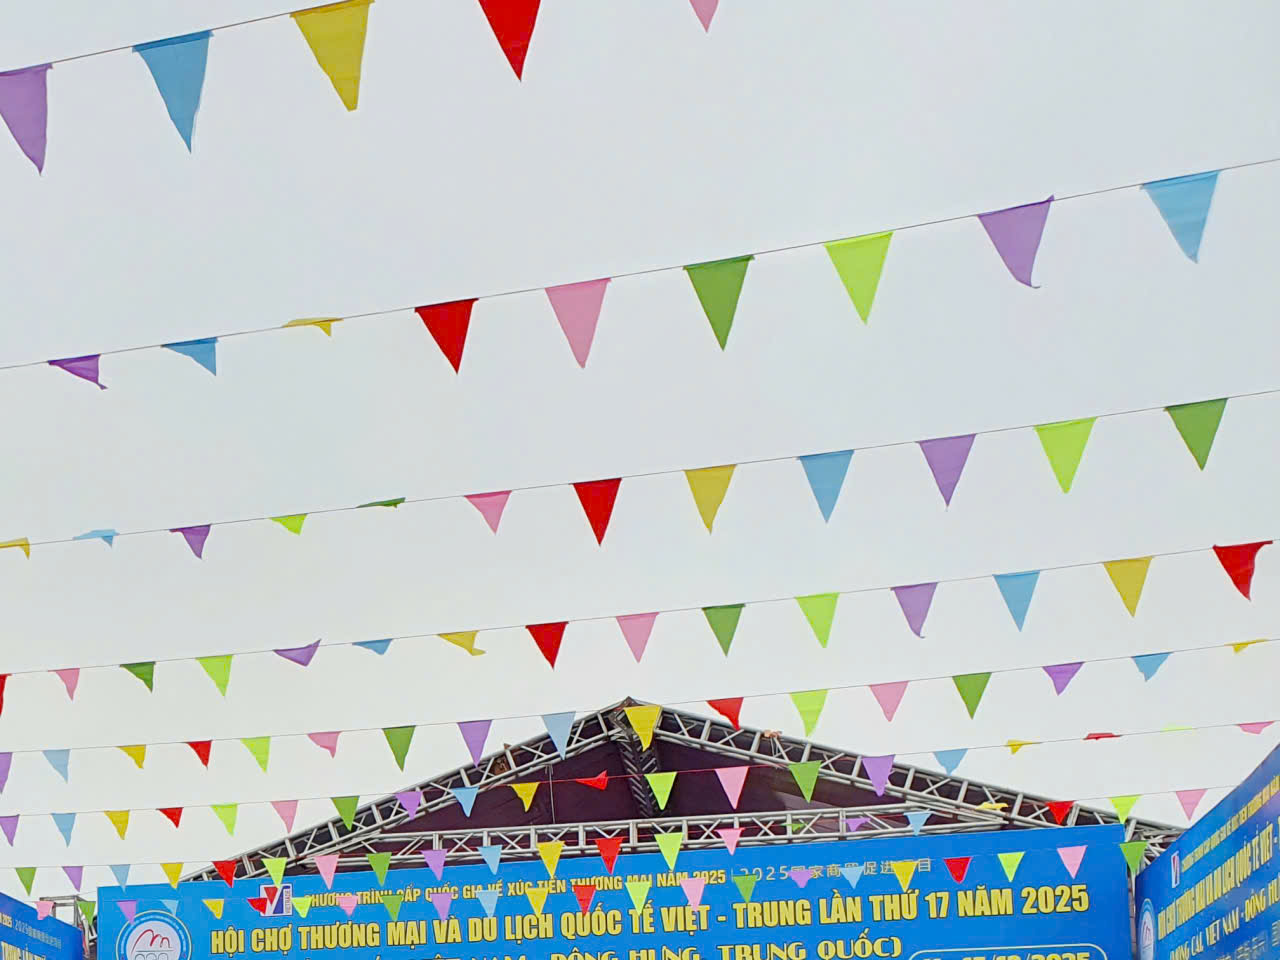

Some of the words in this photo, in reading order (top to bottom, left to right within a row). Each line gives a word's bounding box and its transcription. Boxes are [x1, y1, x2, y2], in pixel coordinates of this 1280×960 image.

[211, 926, 245, 958] HỘI
[251, 923, 293, 956] CHỢ
[298, 921, 380, 950] THƯƠNG
[387, 919, 427, 949] MẠI
[433, 916, 462, 944] VÀ
[468, 916, 498, 942] DU
[505, 913, 554, 945] LỊCH
[560, 902, 623, 940] QUỐC
[628, 900, 655, 934] TẾ
[660, 904, 711, 936] VIỆT
[732, 898, 812, 929] TRUNG
[819, 888, 862, 924] LẦN
[869, 888, 920, 921] THỨ
[925, 891, 950, 919] 17
[957, 885, 1014, 917] NĂM
[1021, 884, 1089, 914] 2025
